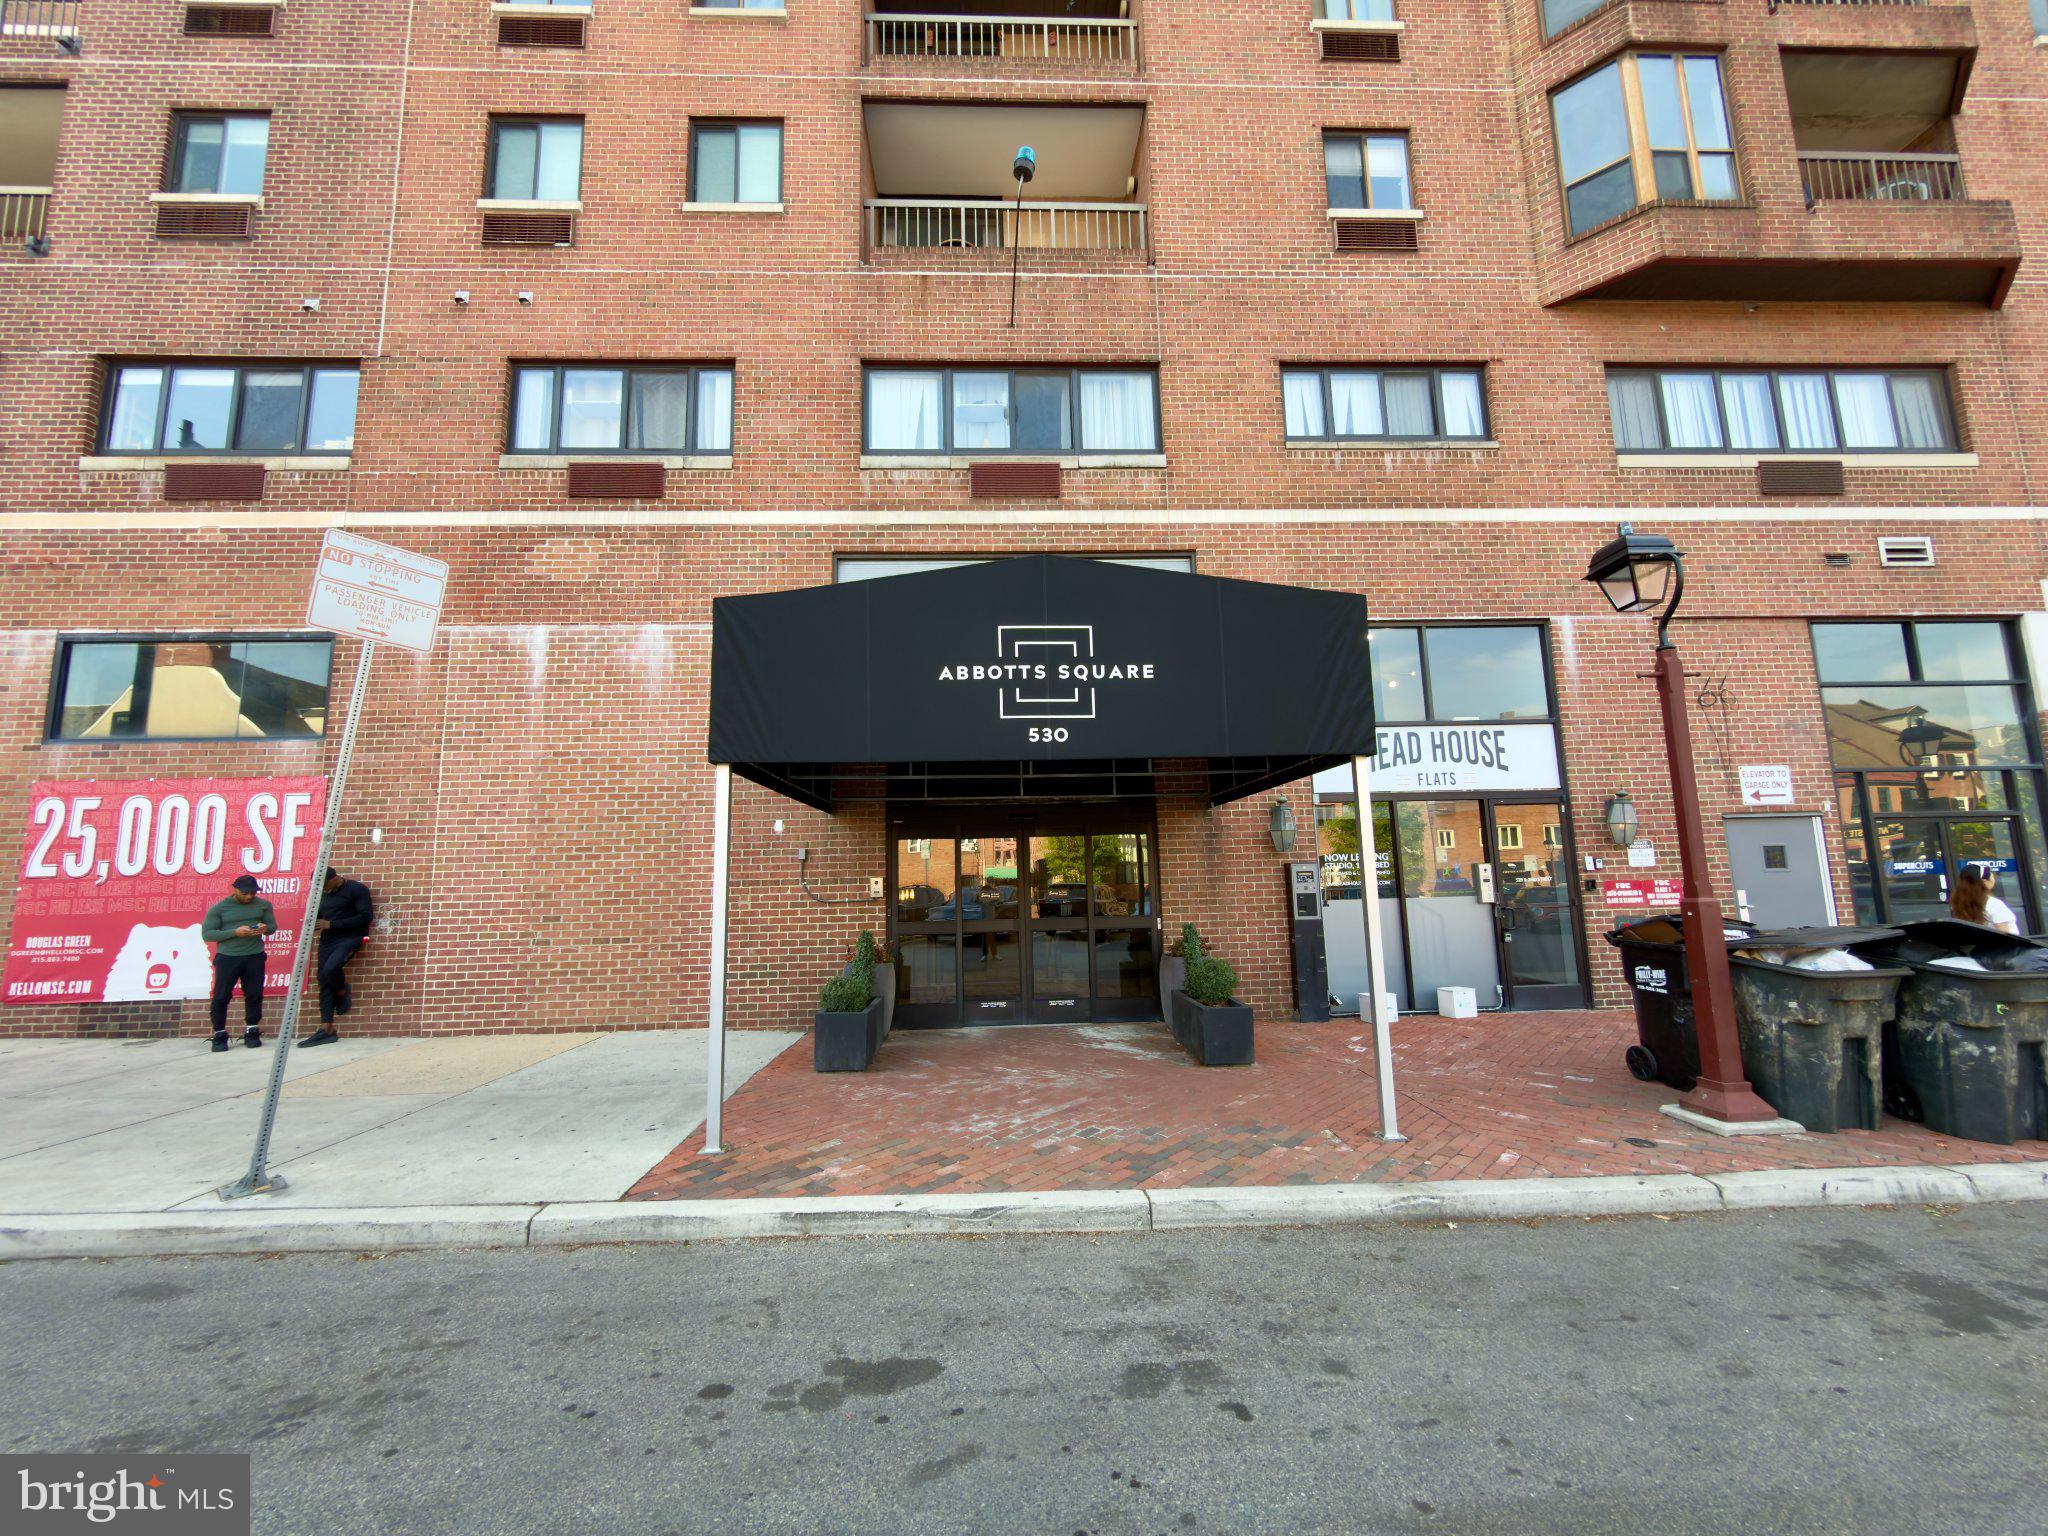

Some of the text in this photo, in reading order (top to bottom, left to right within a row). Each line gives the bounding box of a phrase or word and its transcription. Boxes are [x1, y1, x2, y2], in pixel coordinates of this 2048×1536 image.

[329, 549, 351, 563] NO
[360, 559, 422, 584] STOPPING
[324, 584, 432, 619] PASSENGER VEHICLE
[337, 596, 417, 624] LOADING ONLY
[938, 664, 1155, 682] ABBOTTS SQUARE
[1028, 727, 1069, 743] 530
[1430, 729, 1509, 772] HOUSE
[1418, 772, 1457, 786] FLATS
[1741, 770, 1787, 778] ELEVATOR TO
[1744, 780, 1788, 789] GARAGE ONLY
[26, 792, 311, 886] 25,000 SF
[1324, 852, 1389, 862] NOW LENG
[1893, 861, 1934, 870] SUPERCUTS
[25, 935, 92, 949] DOUGLAS GREEN
[11, 948, 104, 957] DGREEN@HELLOMSC.COM
[8, 980, 92, 996] HELLOMSC.COM
